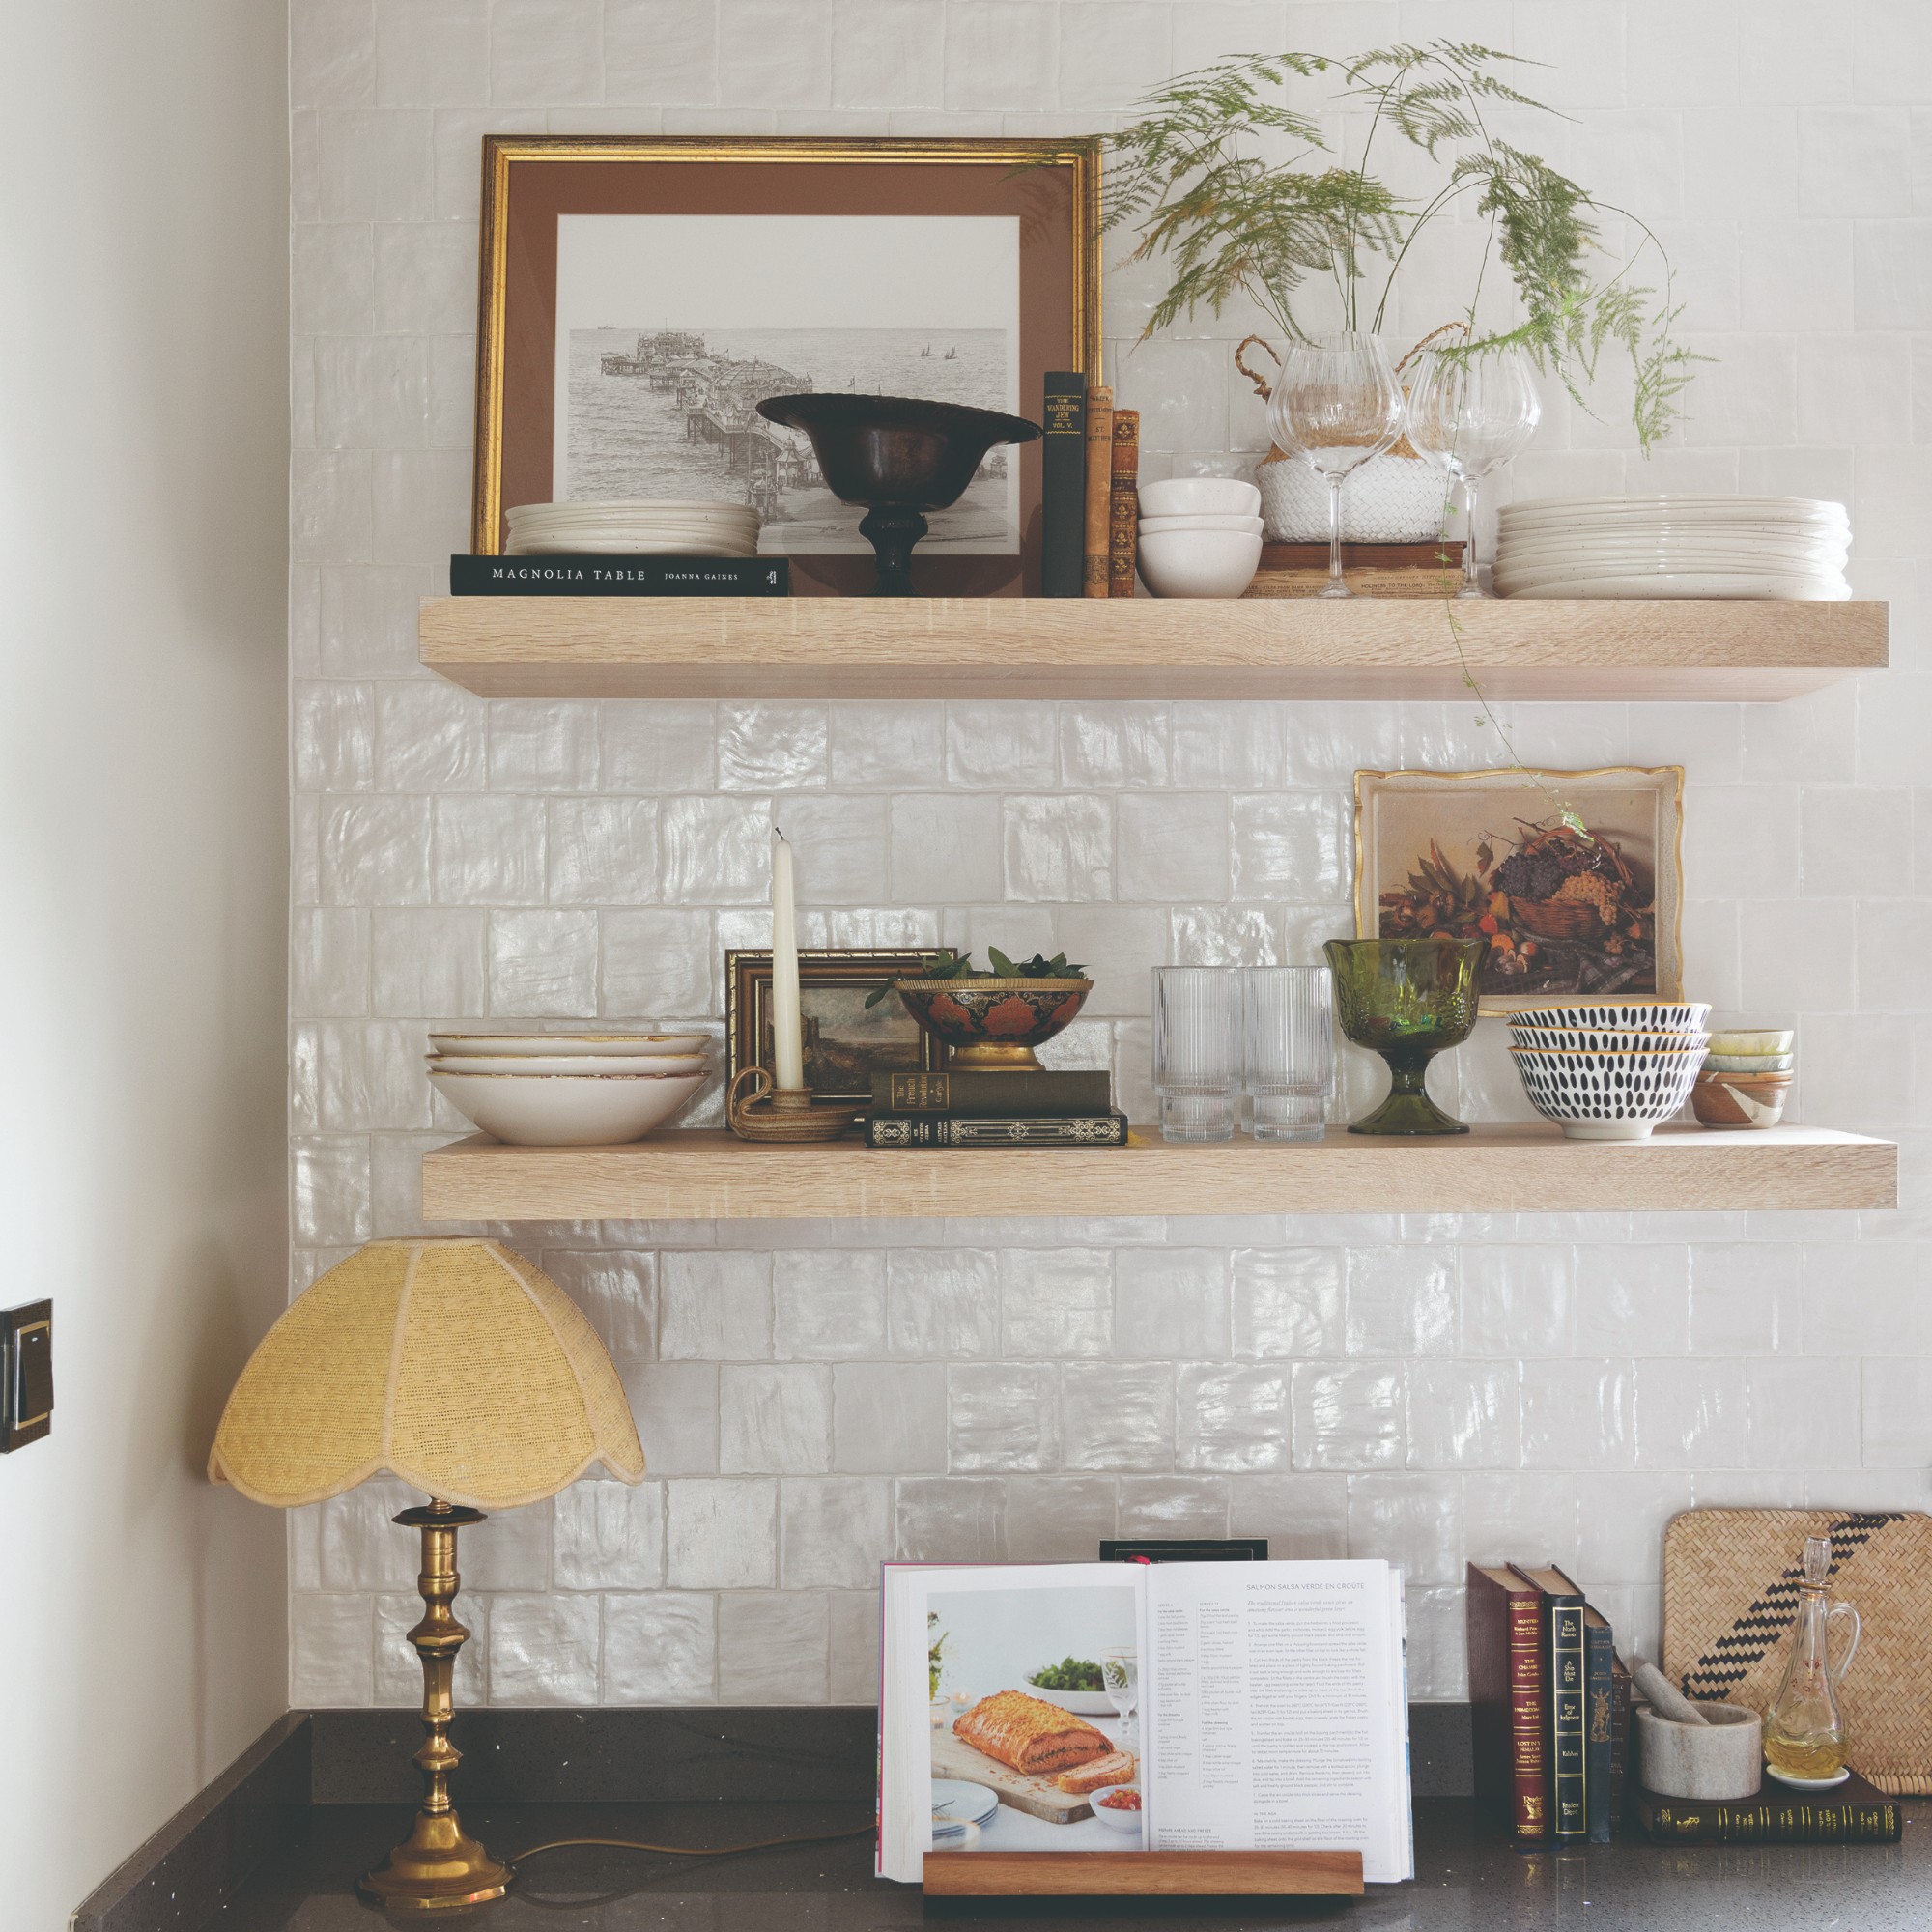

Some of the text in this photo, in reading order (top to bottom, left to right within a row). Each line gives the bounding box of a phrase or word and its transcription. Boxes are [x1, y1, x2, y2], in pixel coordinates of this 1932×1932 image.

[492, 567, 646, 581] MAGNOLIA TABLE
[664, 572, 700, 581] JOANNA
[906, 1078, 916, 1105] French
[919, 1074, 928, 1108] Revolution
